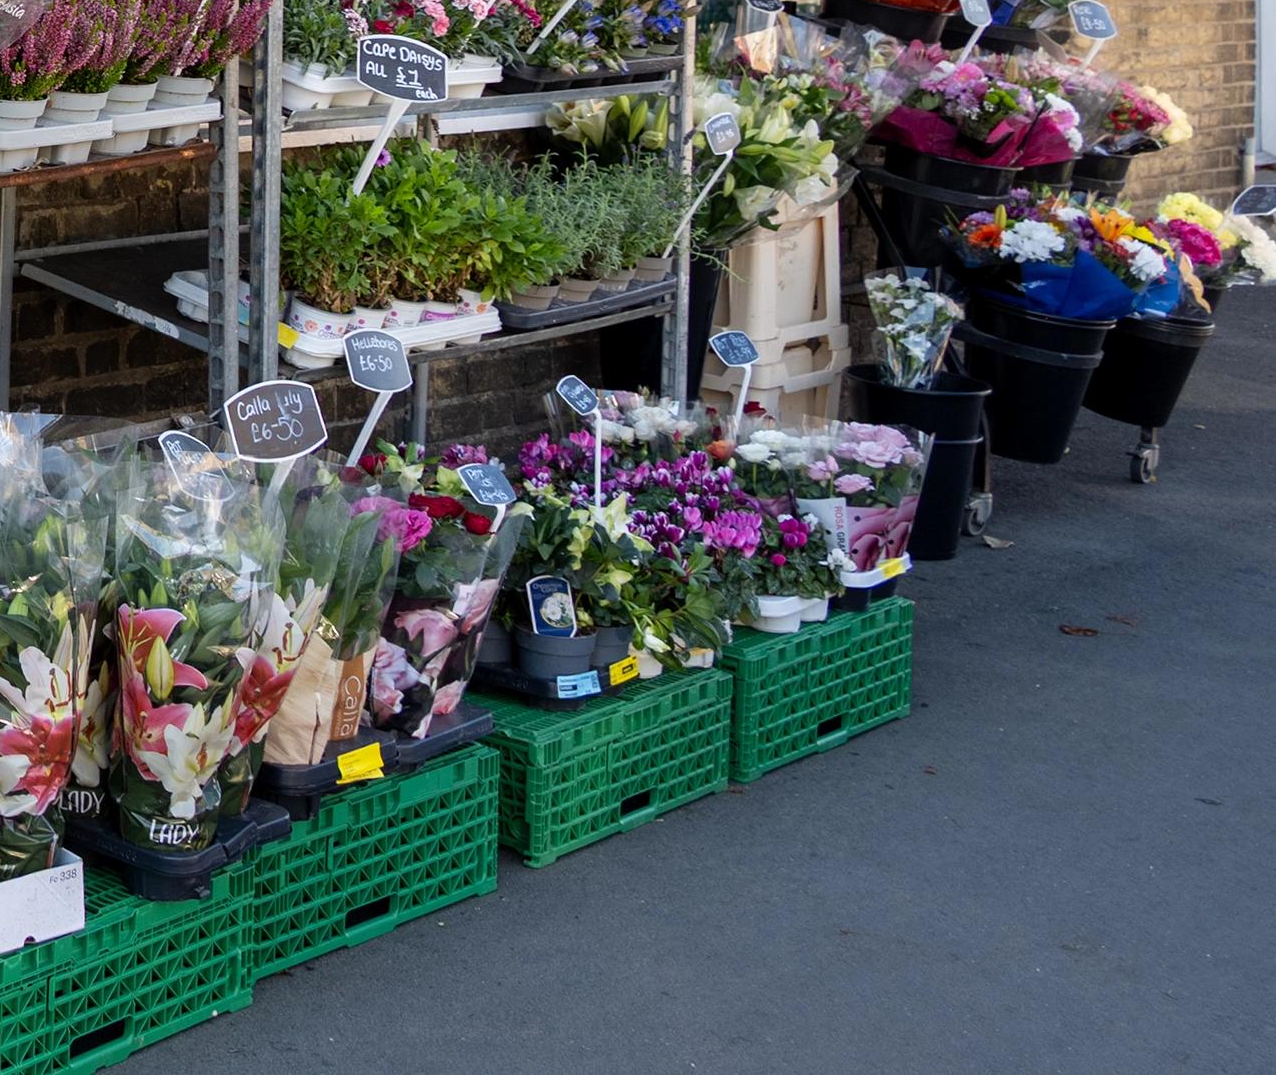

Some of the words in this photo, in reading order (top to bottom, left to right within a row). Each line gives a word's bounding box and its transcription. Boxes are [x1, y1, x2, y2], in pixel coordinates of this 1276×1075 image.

[237, 395, 271, 421] Calla
[833, 506, 842, 531] ROSA
[839, 531, 849, 554] GRA
[341, 675, 362, 737] Calla
[59, 790, 106, 814] LADY
[149, 818, 200, 845] LADY
[59, 867, 78, 882] 338
